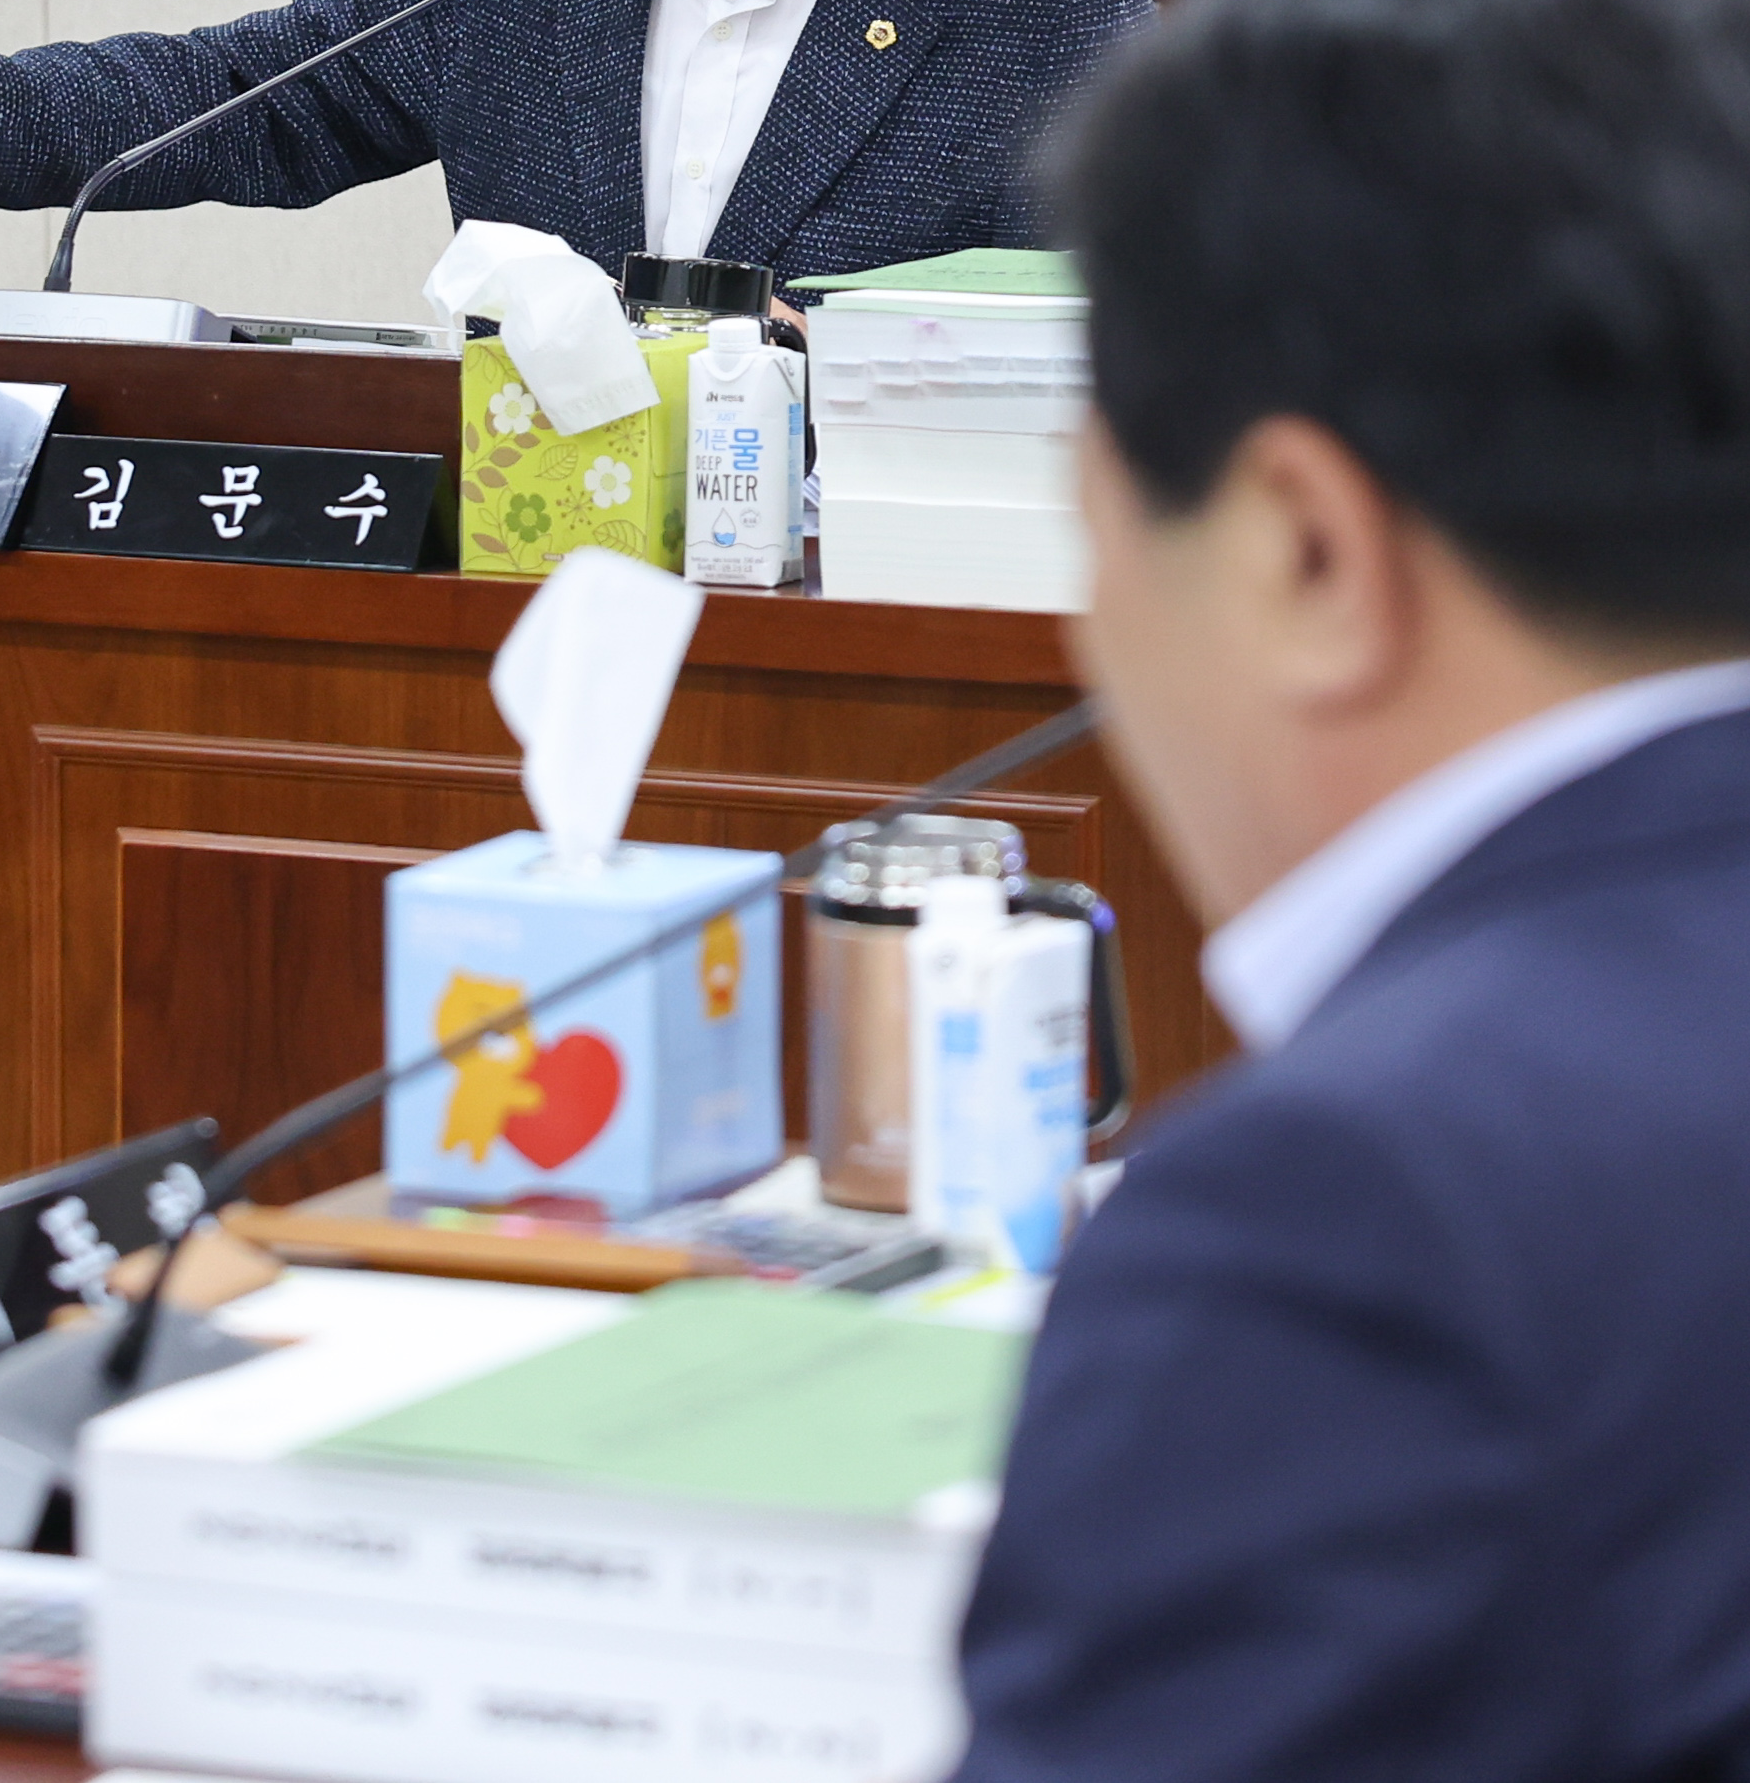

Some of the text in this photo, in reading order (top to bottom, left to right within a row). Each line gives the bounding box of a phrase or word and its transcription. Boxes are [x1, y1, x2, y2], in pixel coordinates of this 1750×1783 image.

[695, 455, 723, 471] DEEP
[728, 427, 764, 471] 물
[695, 473, 759, 502] WATER
